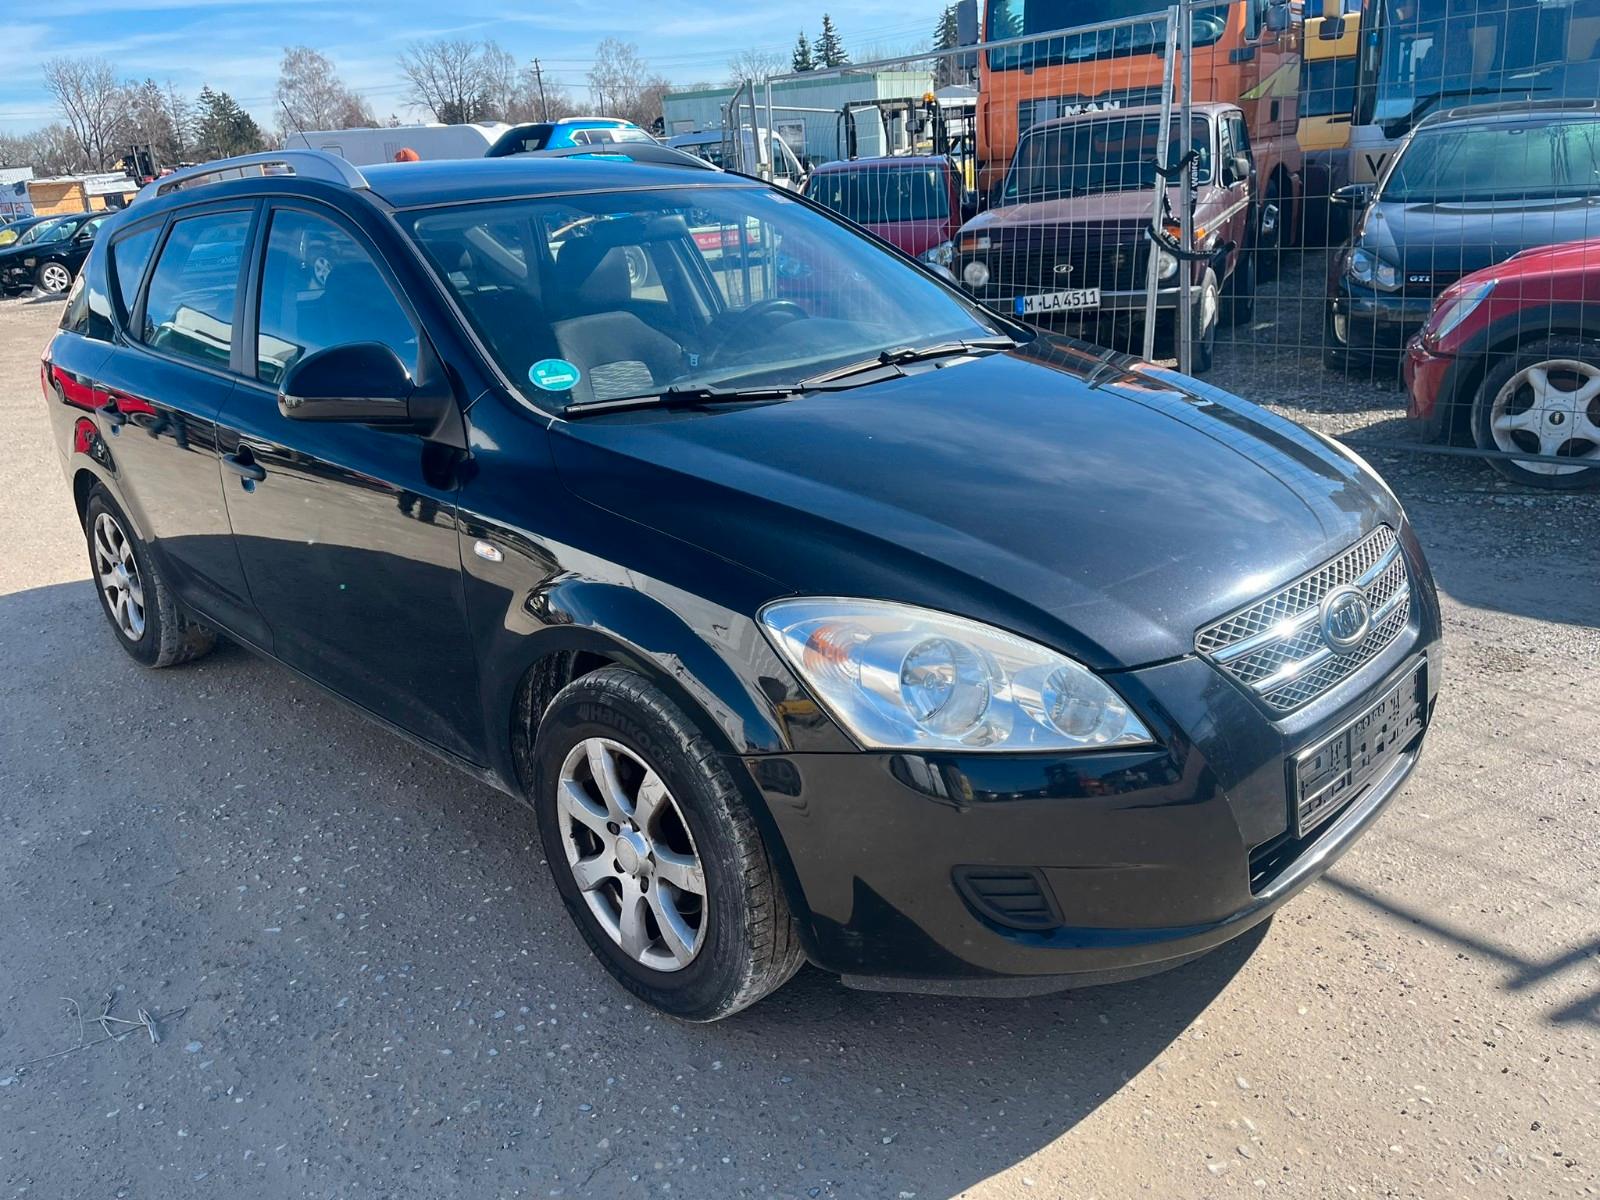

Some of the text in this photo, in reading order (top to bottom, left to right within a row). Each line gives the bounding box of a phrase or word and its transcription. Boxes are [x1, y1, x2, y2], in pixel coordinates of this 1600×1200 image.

[1065, 101, 1120, 117] MAN
[1024, 298, 1034, 312] M
[1063, 290, 1098, 307] 4511
